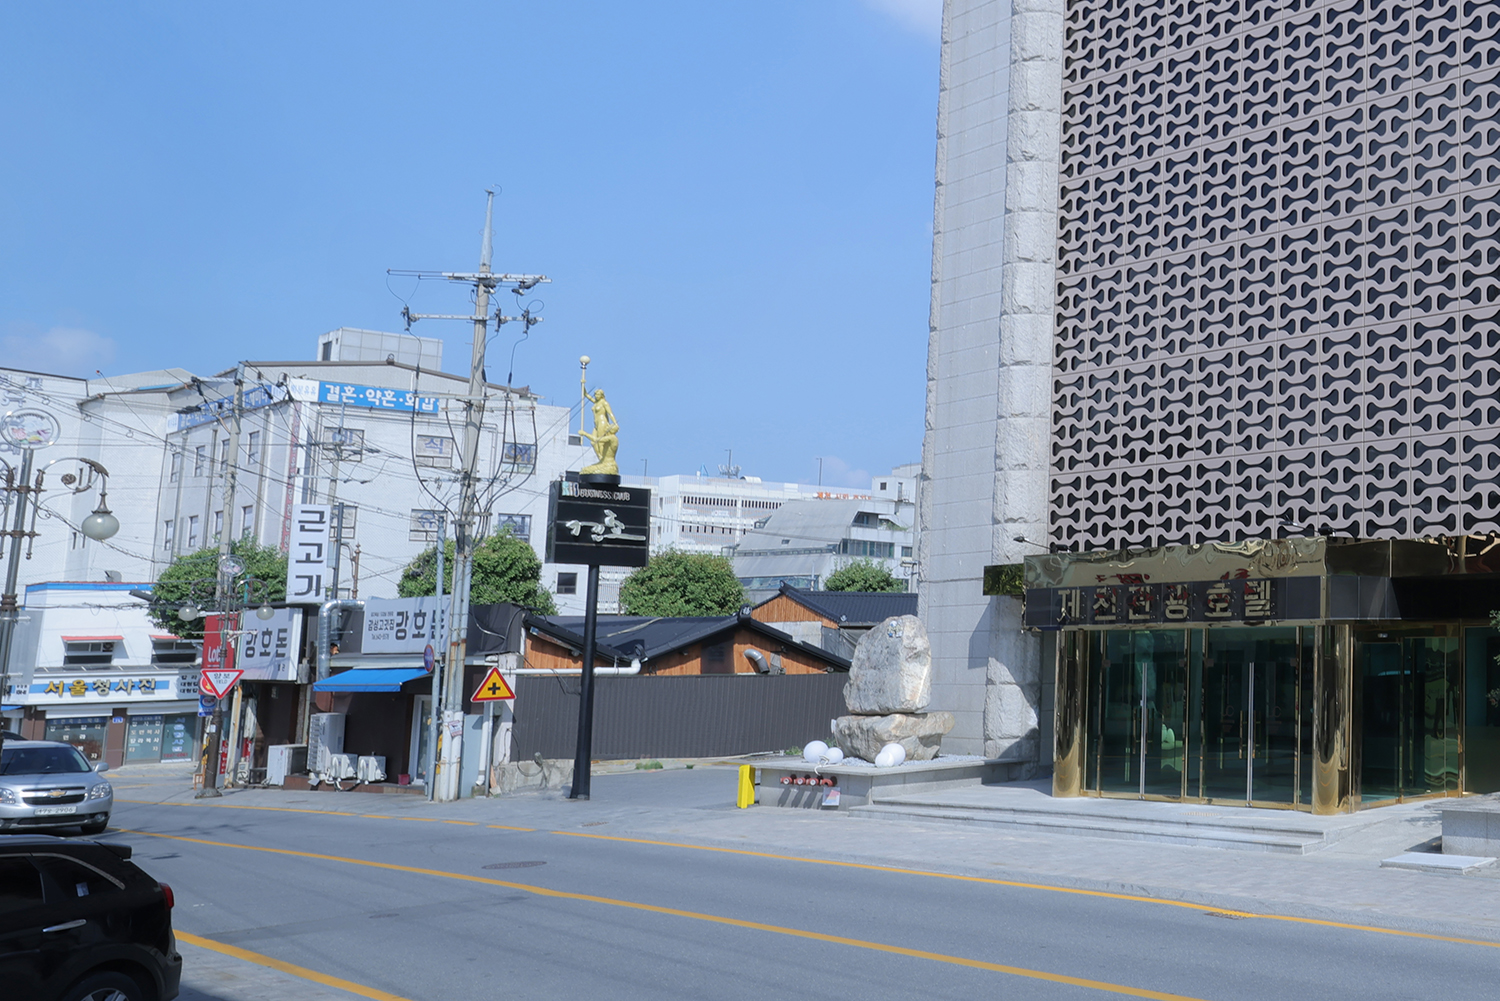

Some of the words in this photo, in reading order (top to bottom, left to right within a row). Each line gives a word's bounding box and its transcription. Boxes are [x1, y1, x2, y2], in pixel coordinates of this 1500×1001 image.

[580, 488, 612, 500] BUSINESS
[613, 492, 631, 501] CLUB
[294, 510, 326, 597] 근고기
[44, 679, 156, 696] 서울청사진
